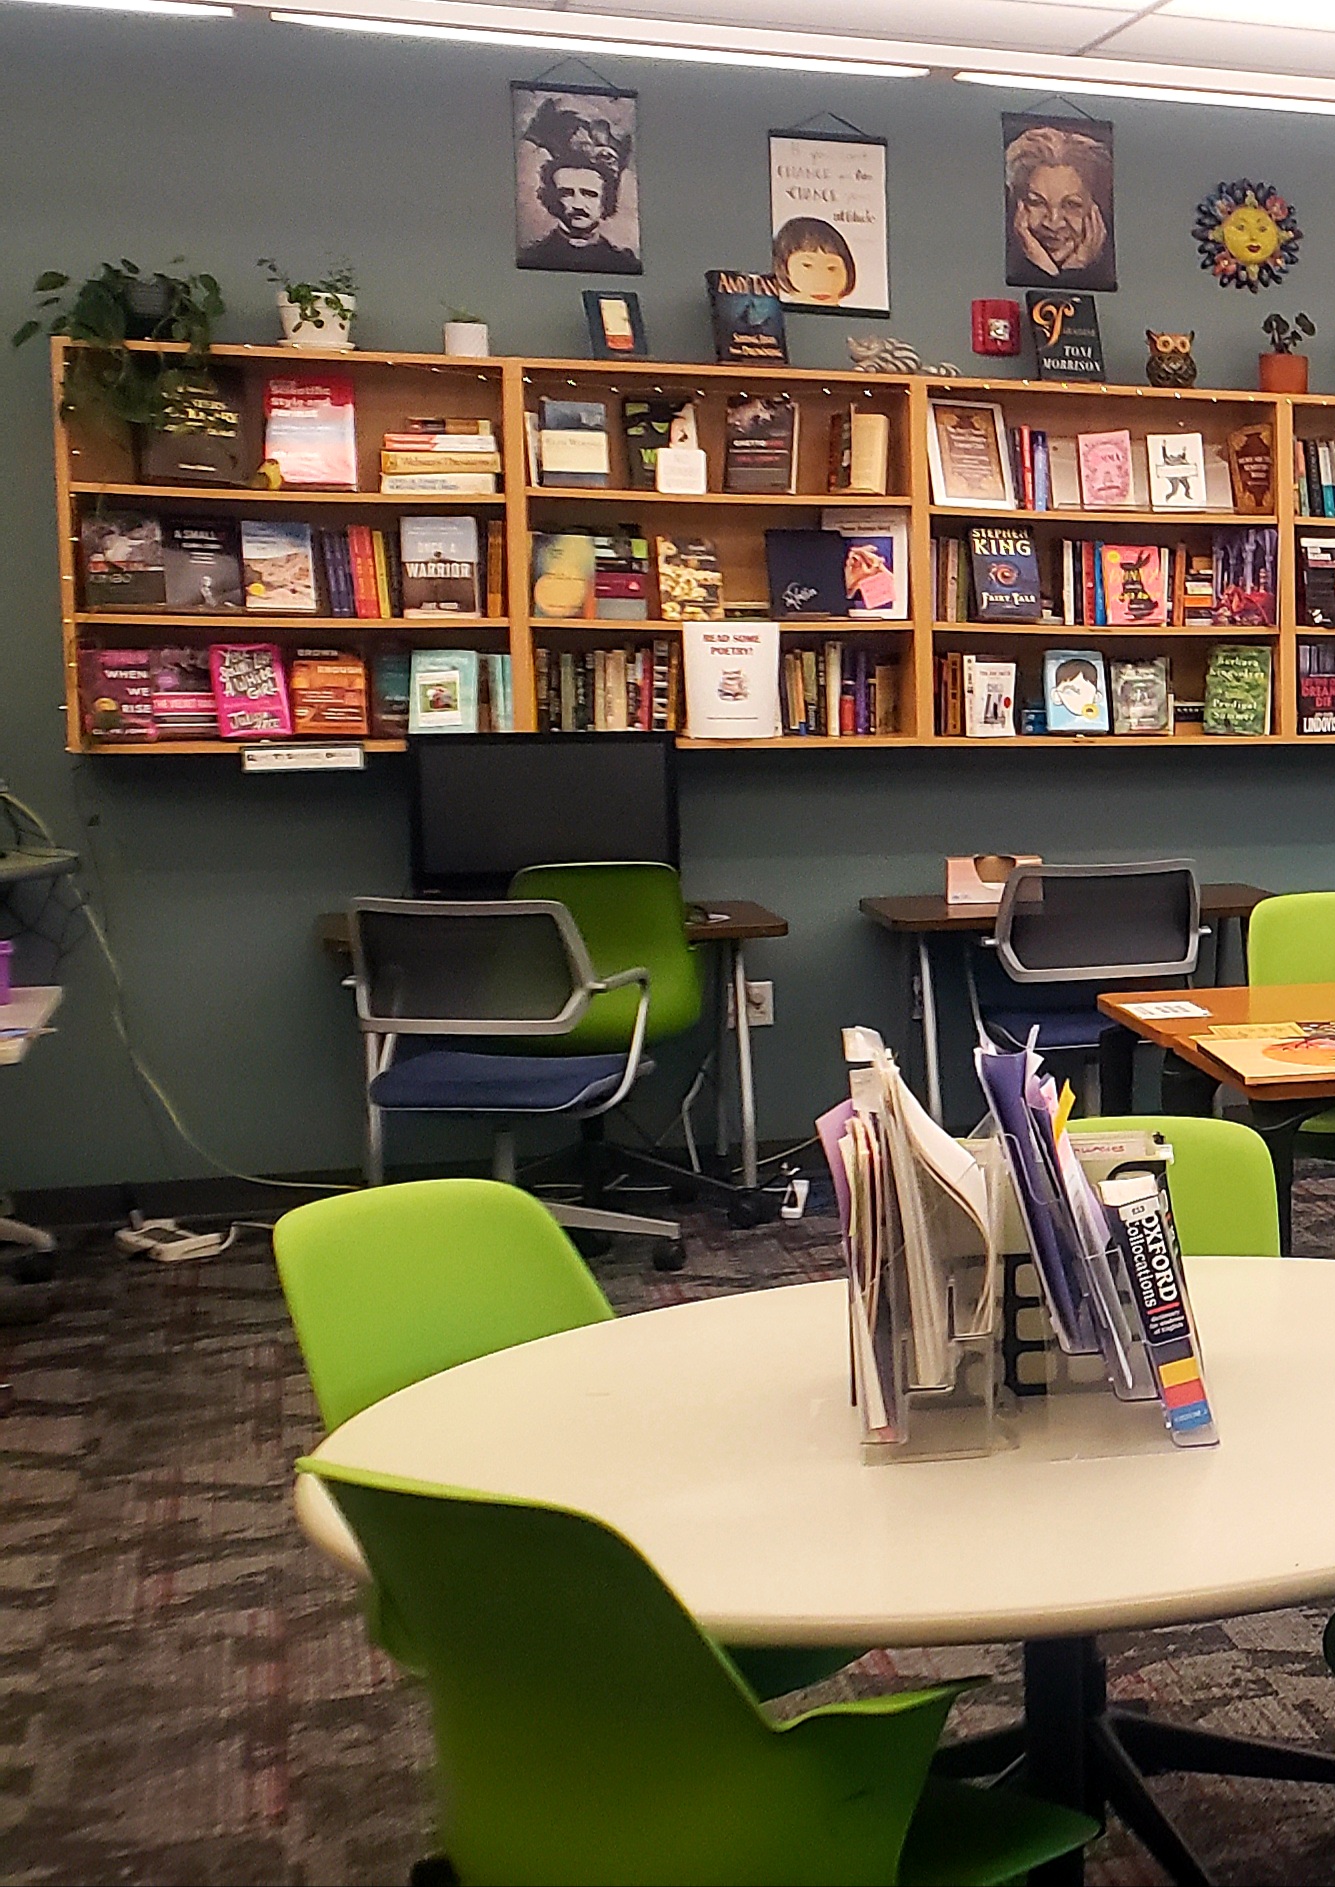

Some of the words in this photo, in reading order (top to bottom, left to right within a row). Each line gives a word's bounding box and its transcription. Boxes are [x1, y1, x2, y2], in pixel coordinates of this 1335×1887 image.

[1063, 345, 1092, 359] TONI
[1043, 357, 1101, 372] MORRISON
[972, 528, 1029, 539] STEPHEN
[973, 539, 1032, 557] KING
[405, 562, 471, 578] WARRIOR
[1217, 656, 1259, 667] Barbara
[104, 669, 149, 679] WHEN
[126, 687, 151, 697] WE
[121, 704, 152, 714] RISE
[1213, 698, 1257, 714] Prodigal
[1141, 1213, 1178, 1302] OXFORD
